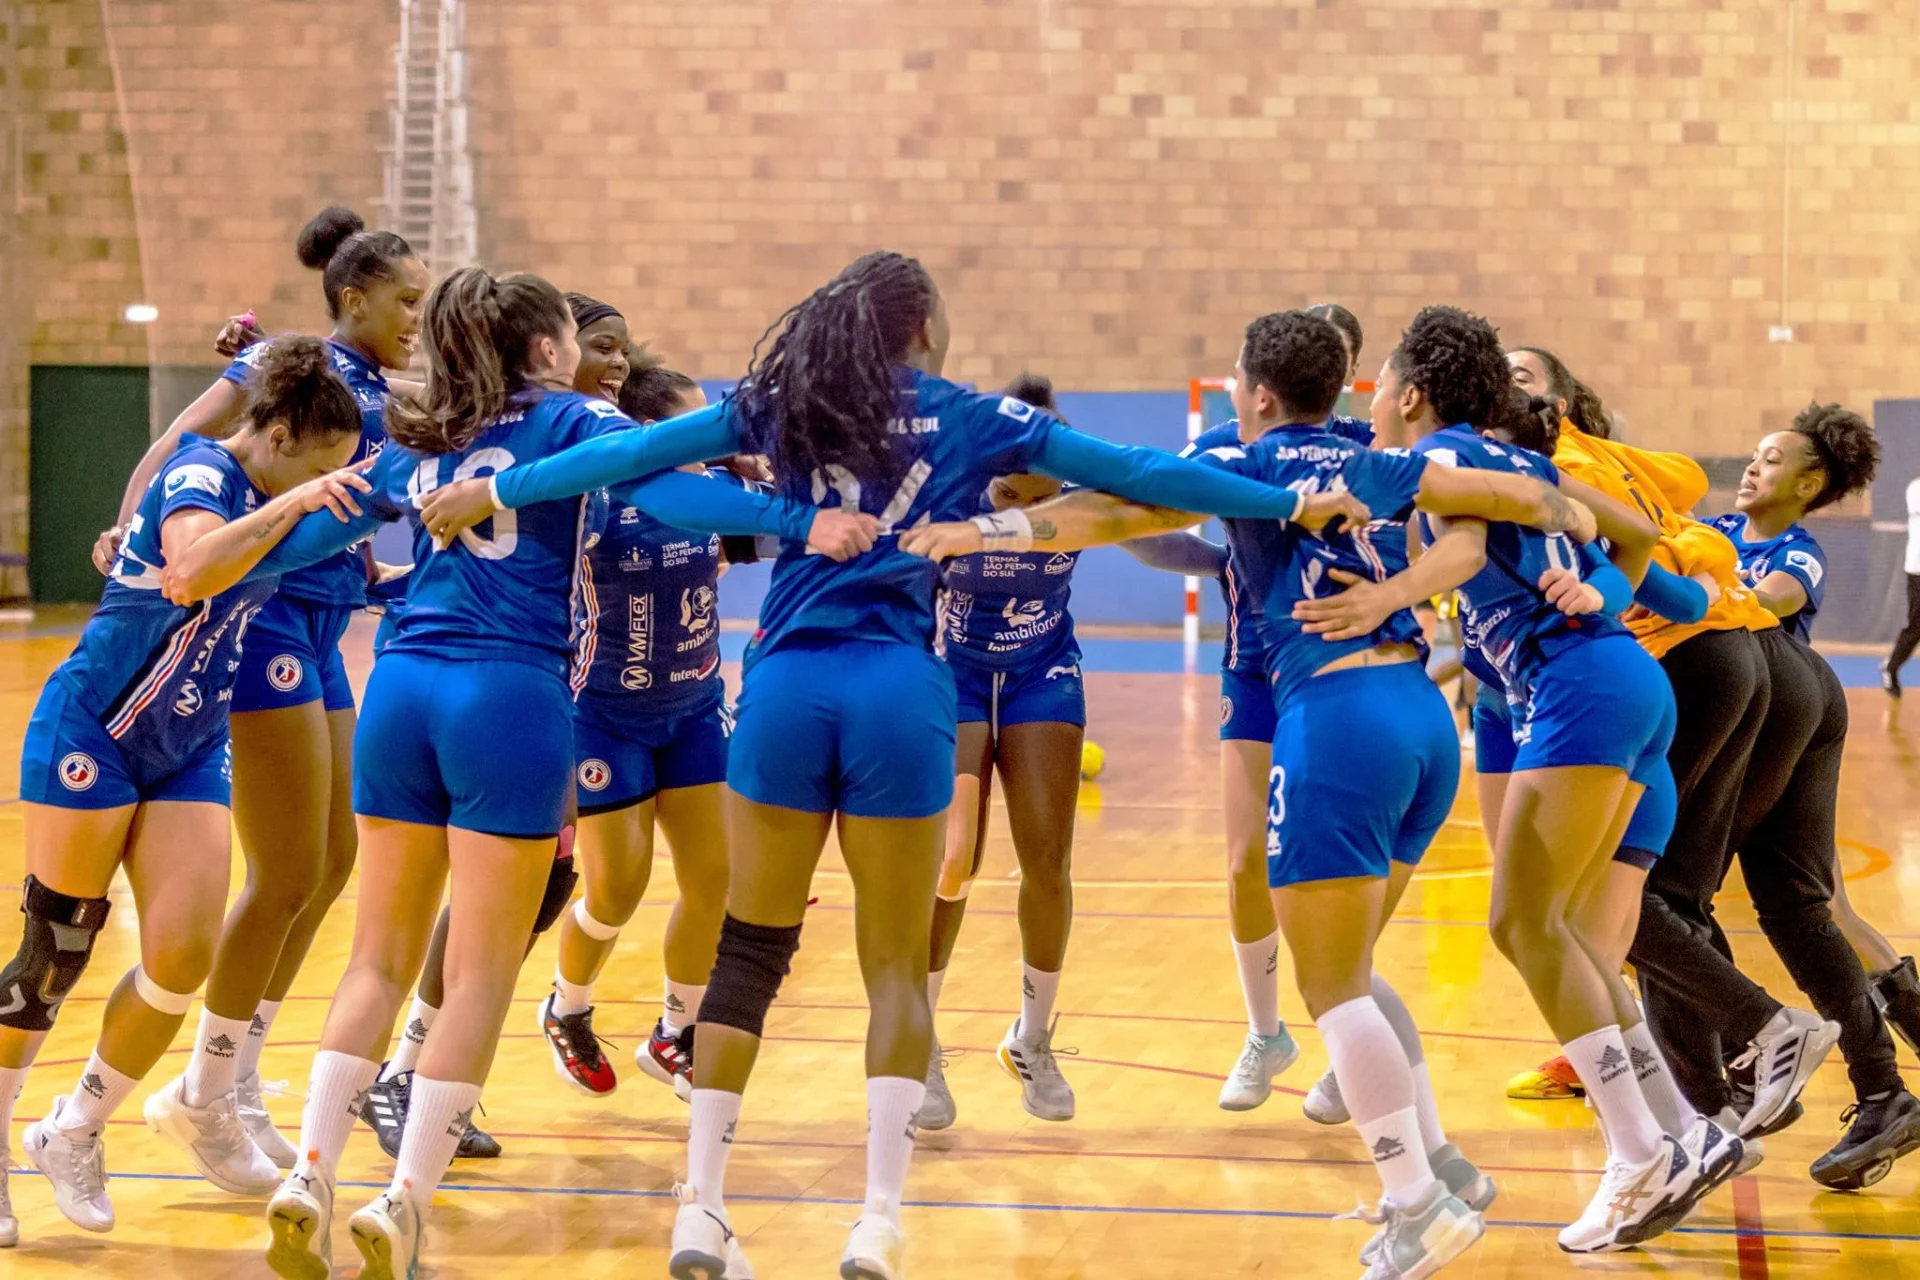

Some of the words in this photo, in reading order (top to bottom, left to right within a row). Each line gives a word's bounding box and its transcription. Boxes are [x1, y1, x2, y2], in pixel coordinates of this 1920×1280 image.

[911, 416, 940, 434] SUL
[662, 540, 690, 552] TERMAS
[679, 545, 704, 557] PEDRO
[663, 559, 675, 568] DO
[675, 556, 690, 565] SUL
[983, 555, 1020, 563] TERMAS
[1004, 562, 1036, 571] PEDRO
[983, 570, 997, 578] DO
[999, 570, 1016, 578] SUL
[627, 595, 648, 662] VMFLEX
[205, 1046, 235, 1059] luanvi
[1601, 1064, 1631, 1086] luanvi
